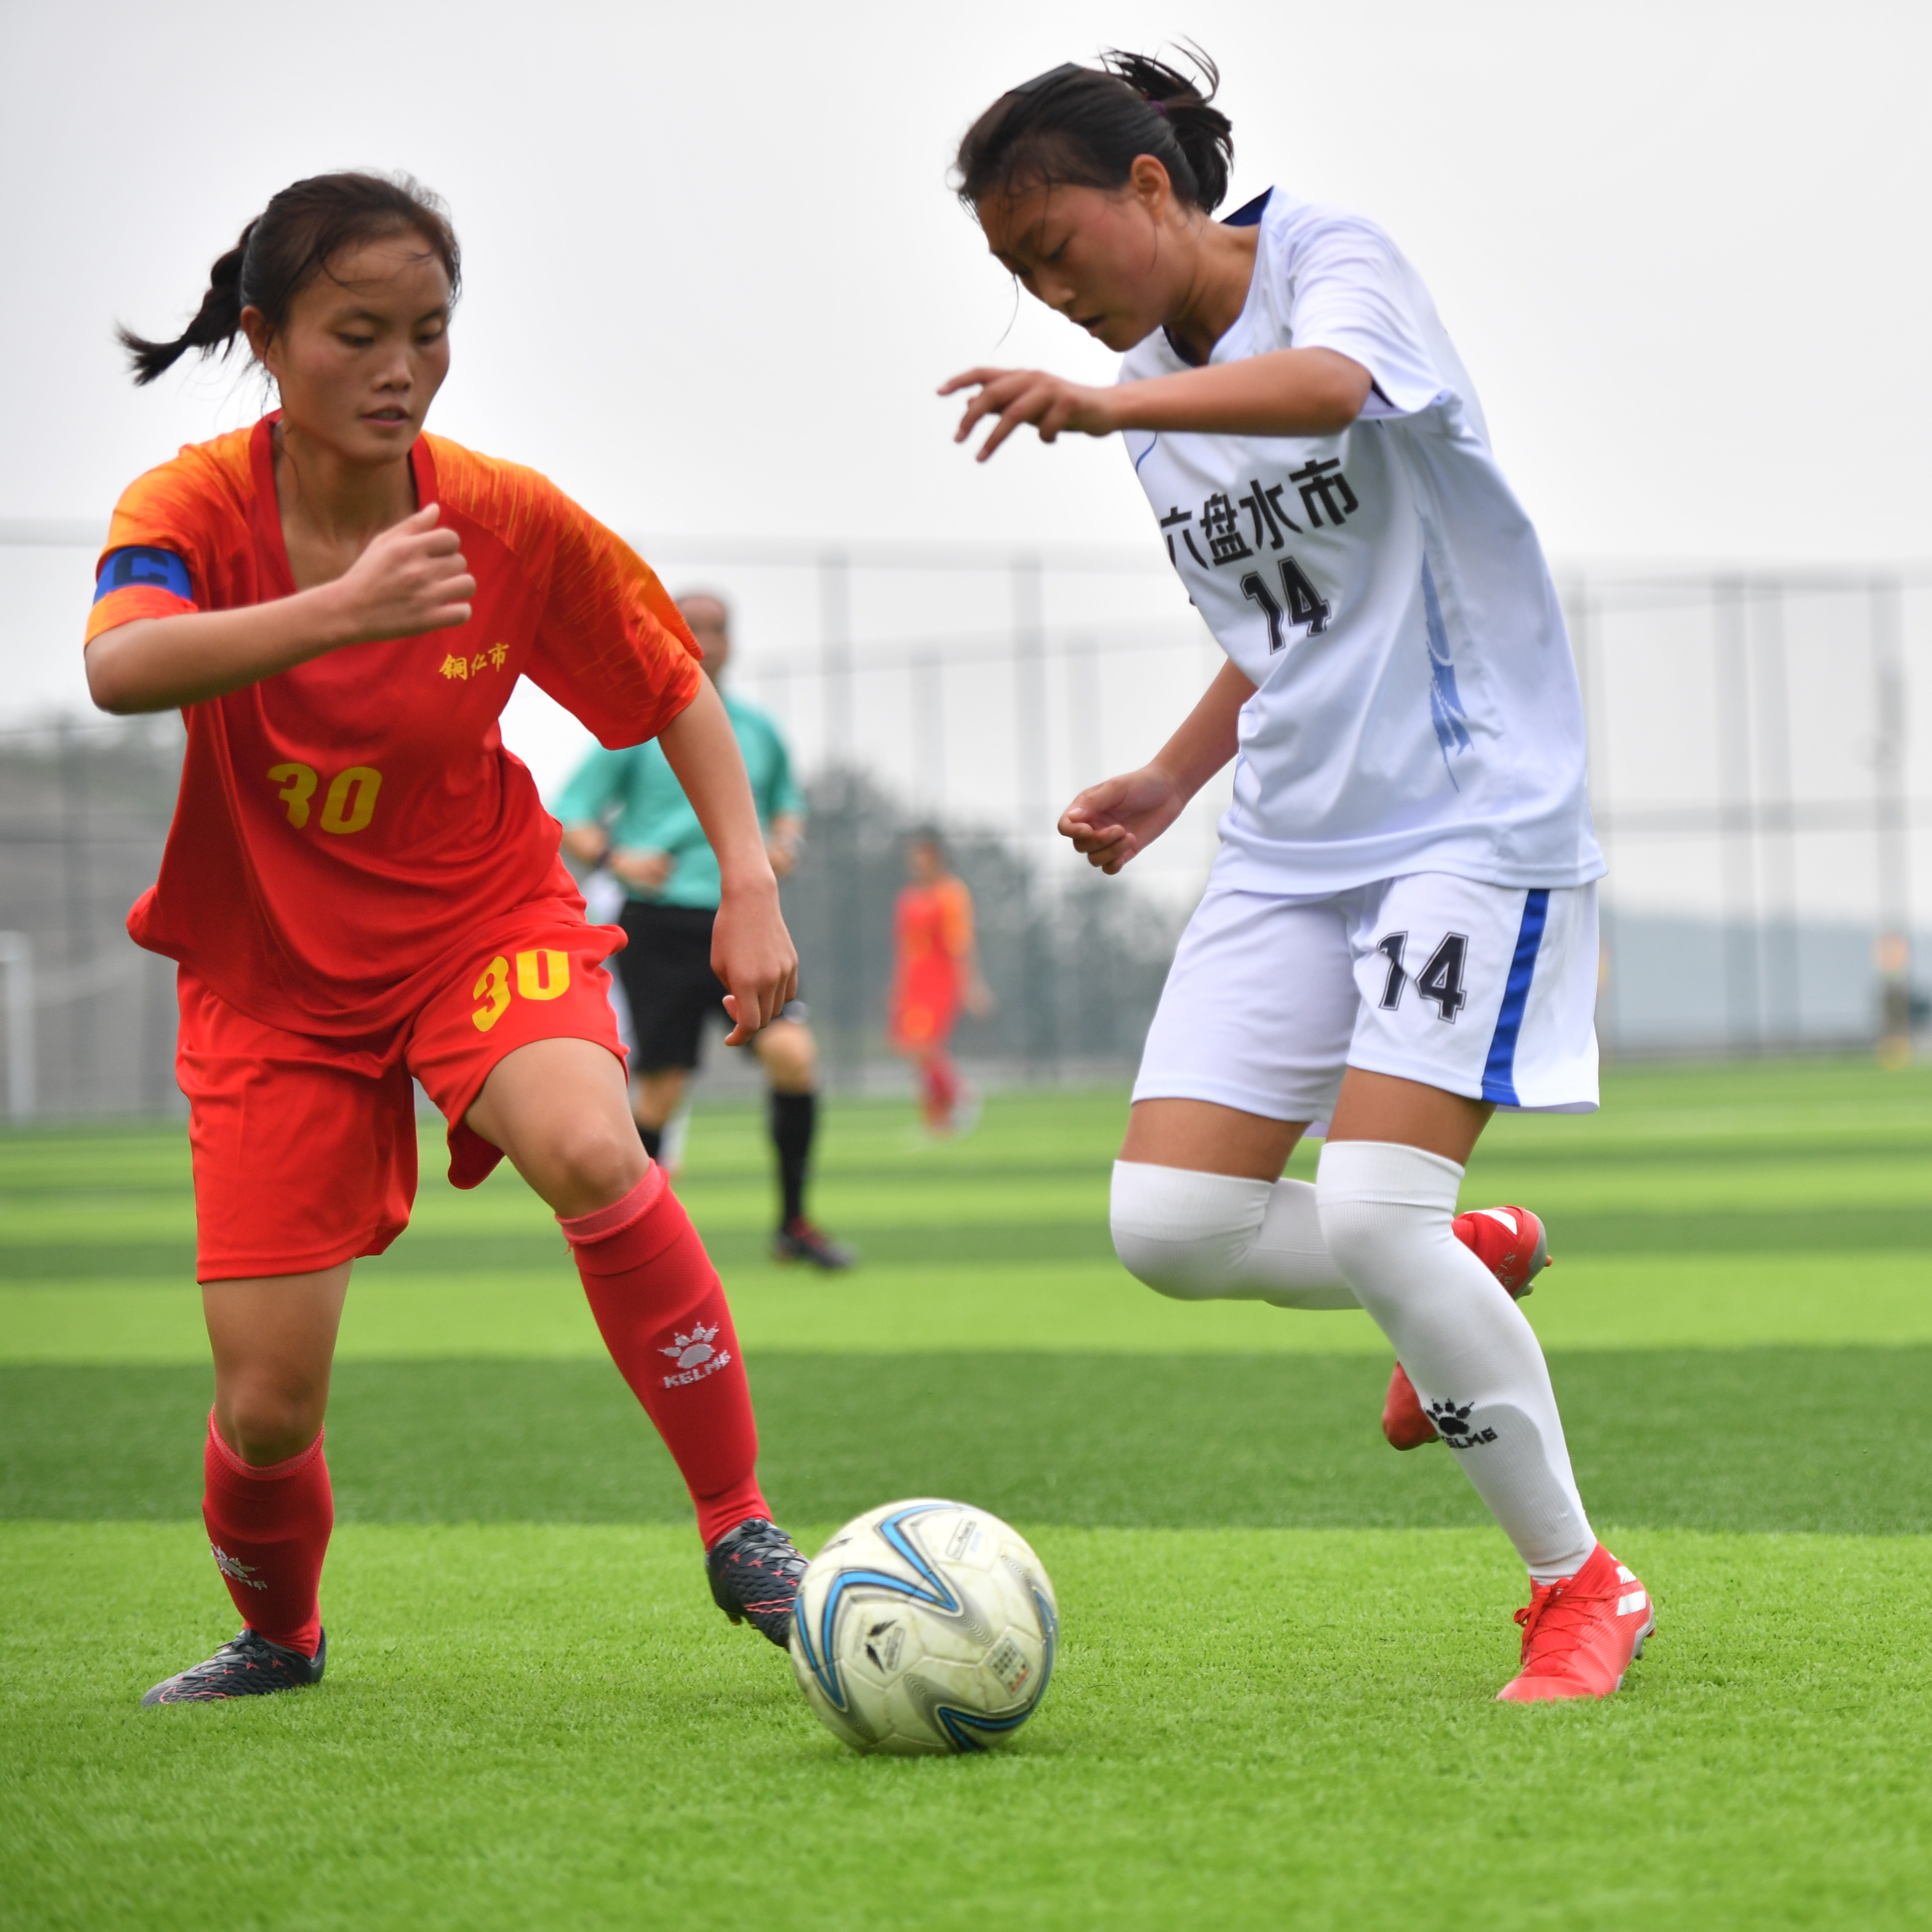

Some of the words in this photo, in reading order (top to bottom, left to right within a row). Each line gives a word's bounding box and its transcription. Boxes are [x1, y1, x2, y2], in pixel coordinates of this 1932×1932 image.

[1160, 457, 1359, 570] 六盘水市
[1240, 556, 1332, 655] 14
[438, 642, 510, 680] 铜仁市
[266, 762, 383, 835] 30
[472, 948, 570, 1033] 30
[1376, 930, 1469, 1025] 14
[663, 1349, 731, 1389] KELME
